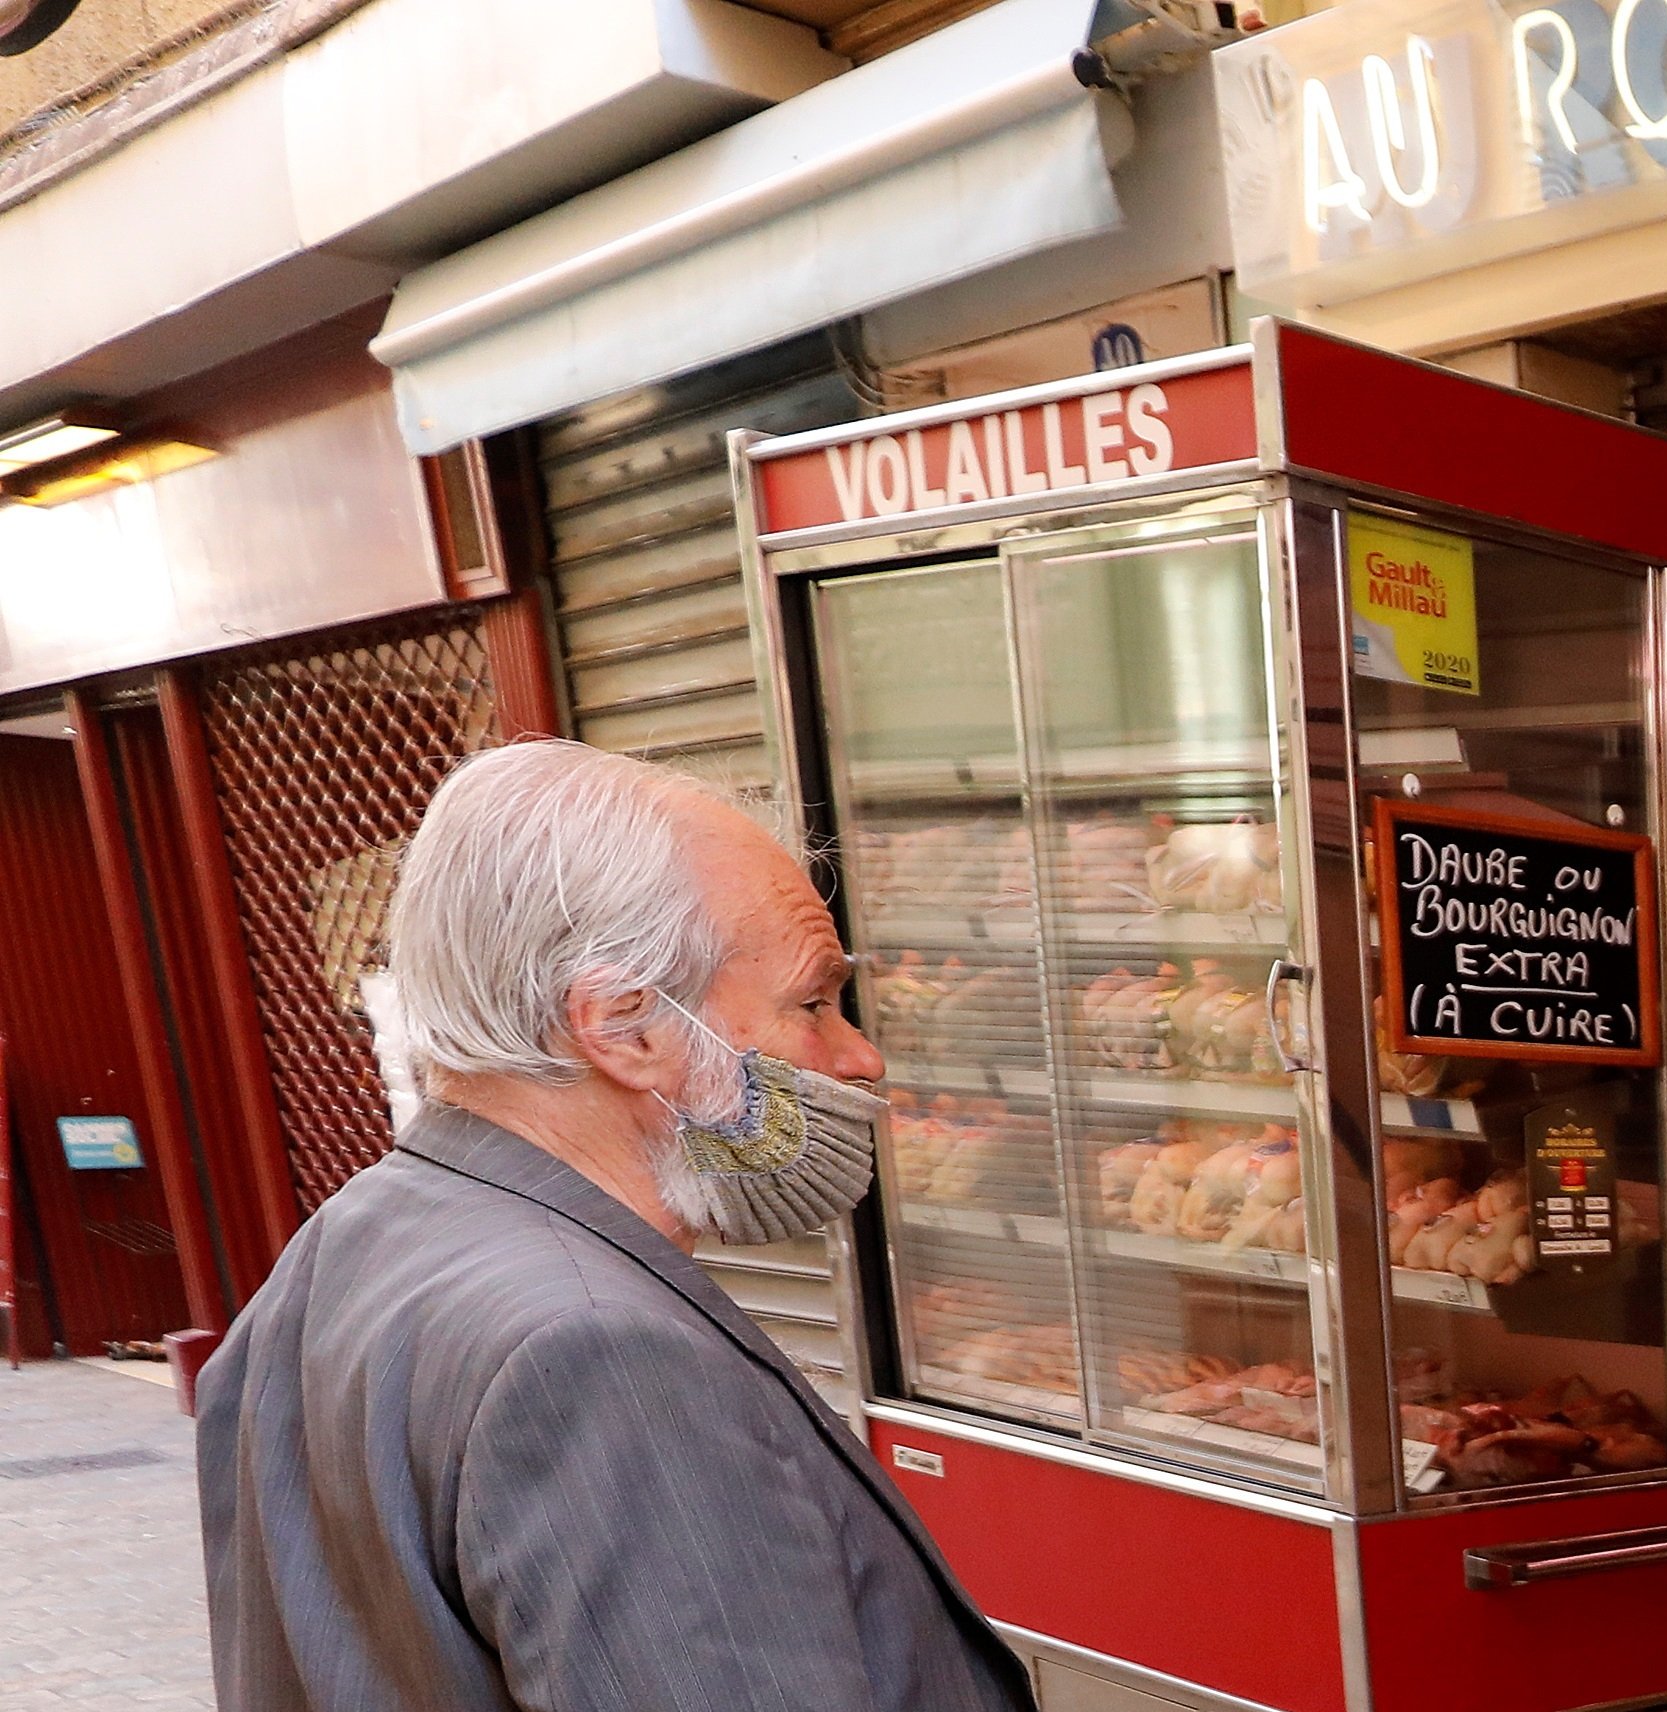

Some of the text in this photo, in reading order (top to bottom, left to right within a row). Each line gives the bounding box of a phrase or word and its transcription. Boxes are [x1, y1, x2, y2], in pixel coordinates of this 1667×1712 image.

[1302, 34, 1462, 242] AU
[827, 383, 1175, 523] VOLAILLES
[1366, 551, 1431, 588] Gault
[1369, 580, 1447, 618] Millau
[1423, 650, 1471, 675] 2020
[1400, 833, 1528, 890] DAUBE
[1456, 943, 1589, 988] EXTRA
